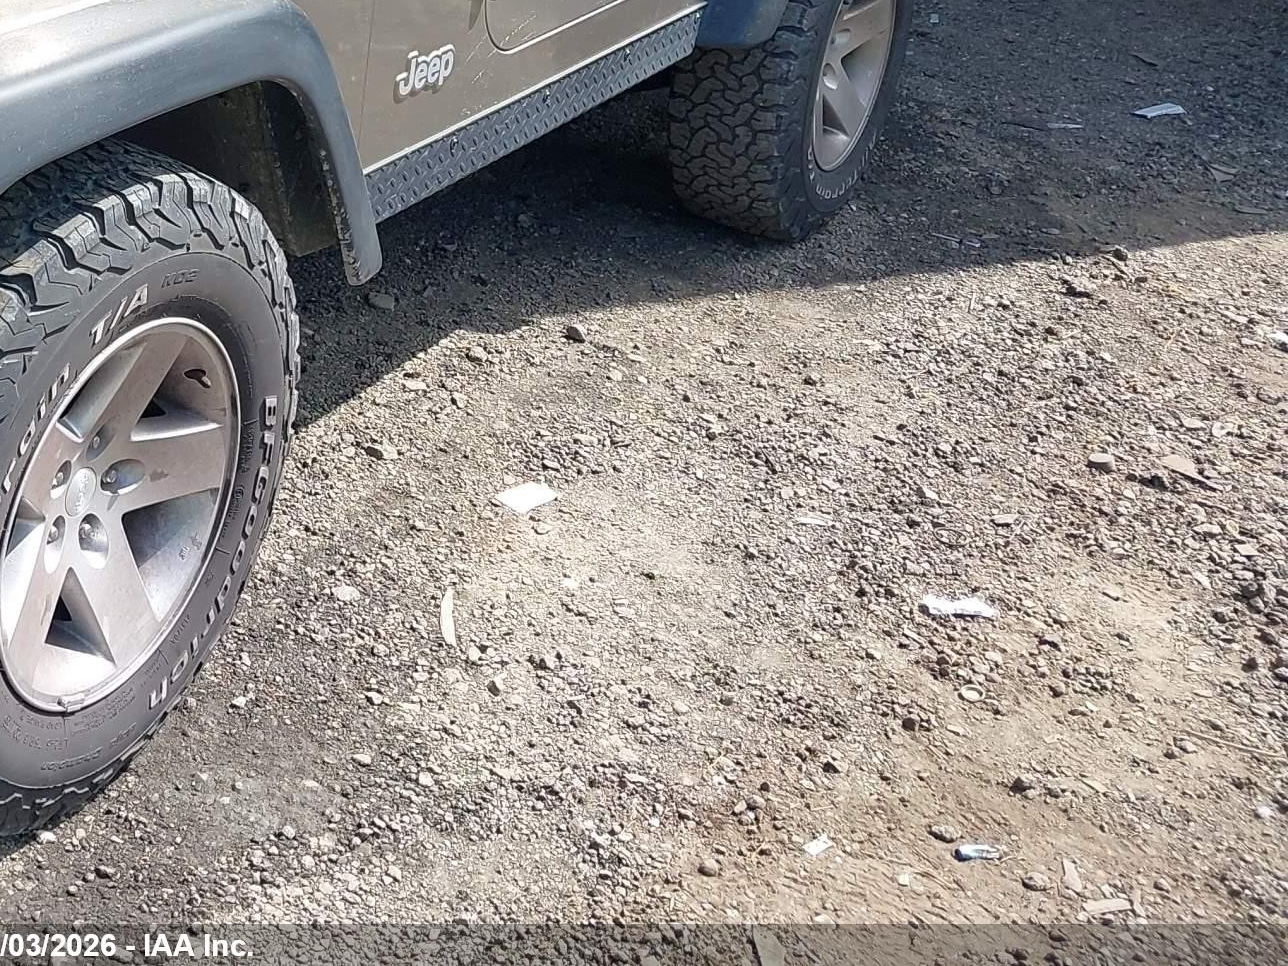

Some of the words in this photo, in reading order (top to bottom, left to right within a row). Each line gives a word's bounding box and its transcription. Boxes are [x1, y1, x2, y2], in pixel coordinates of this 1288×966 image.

[396, 43, 455, 96] Jeep
[88, 284, 149, 347] T/A
[149, 395, 278, 710] BFGoodrich
